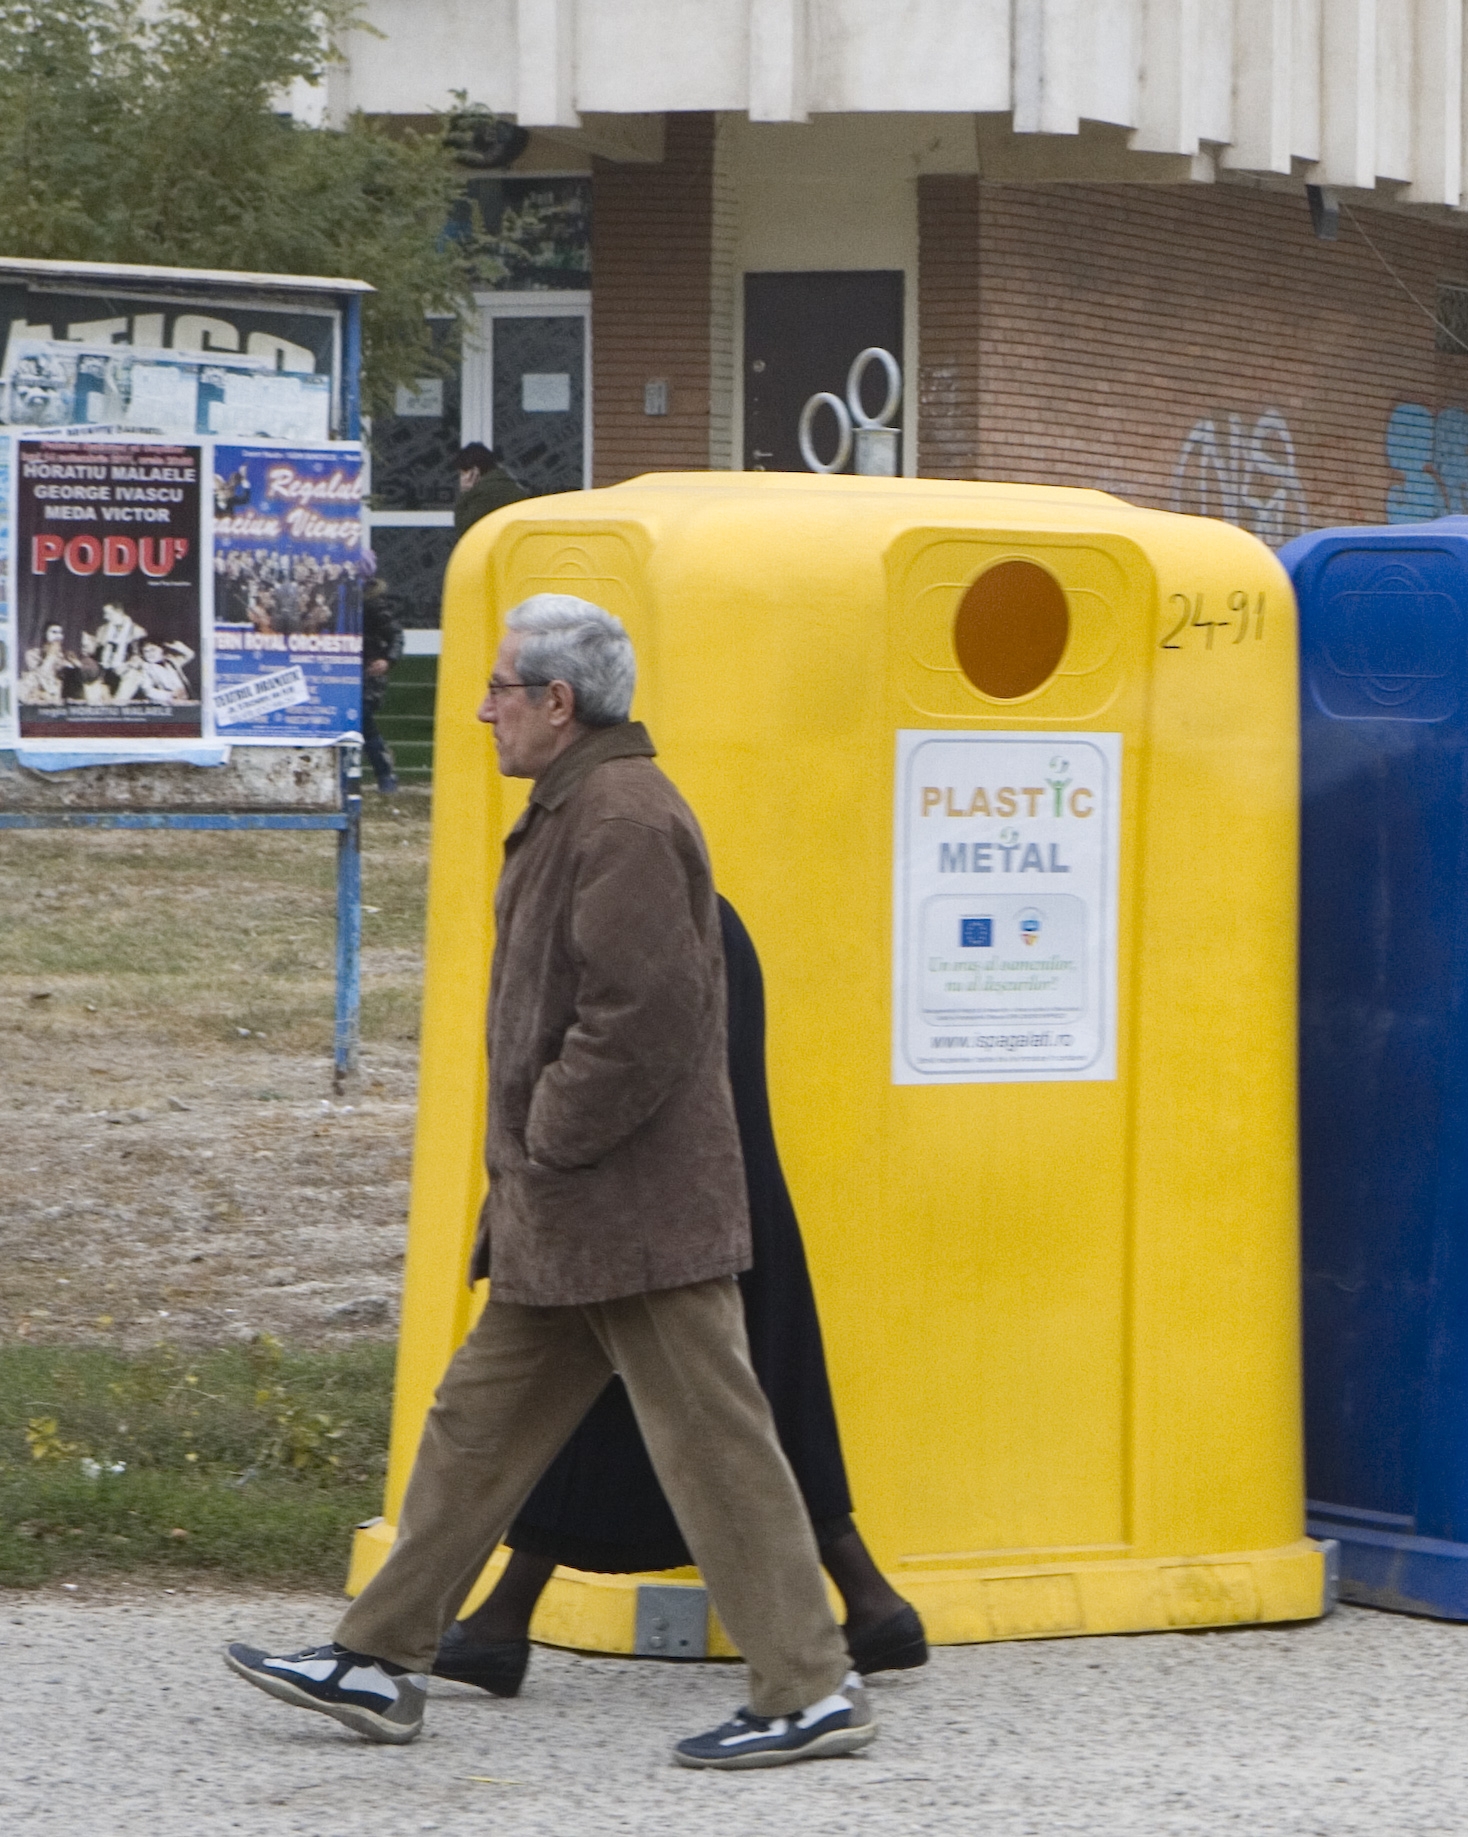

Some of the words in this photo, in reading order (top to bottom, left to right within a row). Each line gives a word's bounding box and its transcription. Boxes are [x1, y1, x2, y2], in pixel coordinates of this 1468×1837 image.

[23, 463, 107, 480] HORATIU
[111, 466, 196, 482] MALAELE
[34, 484, 111, 500] GEORGE
[115, 487, 184, 502] IVASCU
[44, 505, 97, 520] MEDA
[101, 507, 170, 522] VICTOR
[920, 779, 1094, 818] PLASTIC
[939, 842, 1070, 874] METAL
